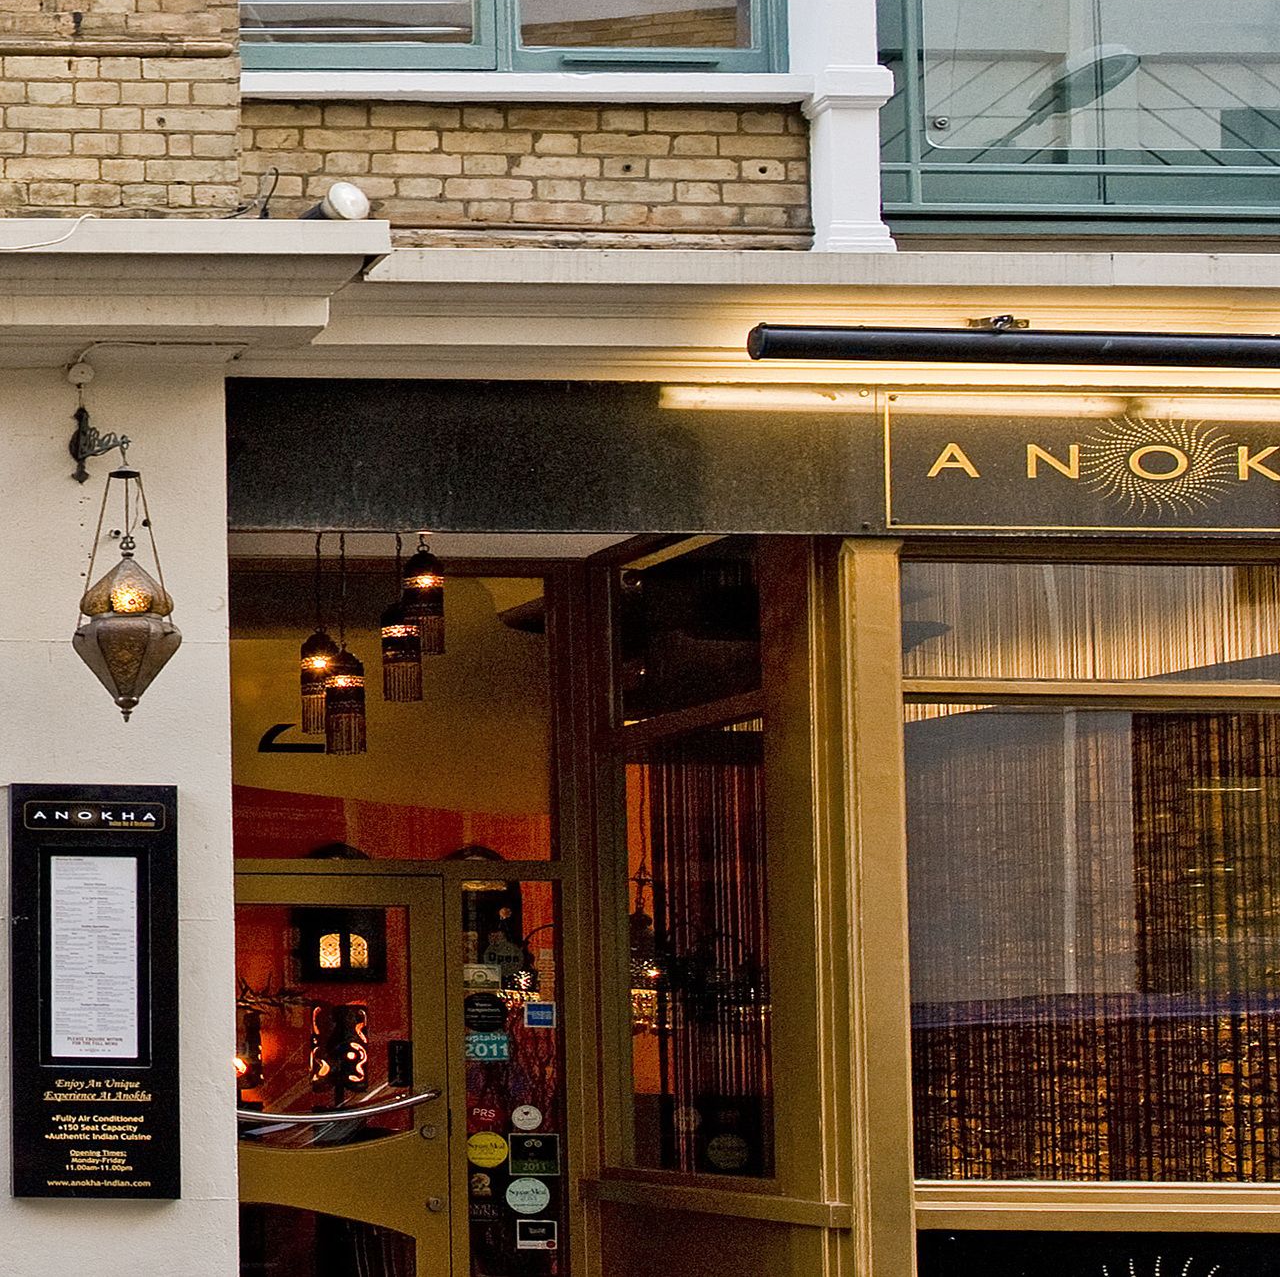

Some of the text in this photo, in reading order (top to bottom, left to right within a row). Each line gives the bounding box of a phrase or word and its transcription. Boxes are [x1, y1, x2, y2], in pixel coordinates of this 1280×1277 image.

[33, 810, 156, 821] ANOKHA
[466, 1043, 509, 1057] 2011
[54, 1079, 140, 1091] Enjoy An Unique
[43, 1090, 152, 1102] Experience At Anokha
[472, 1108, 496, 1118] PRS
[56, 1115, 77, 1123] Fully
[101, 1124, 138, 1133] Capacity
[70, 1149, 101, 1157] Opening
[47, 1179, 152, 1187] www.anokha-indian.com
